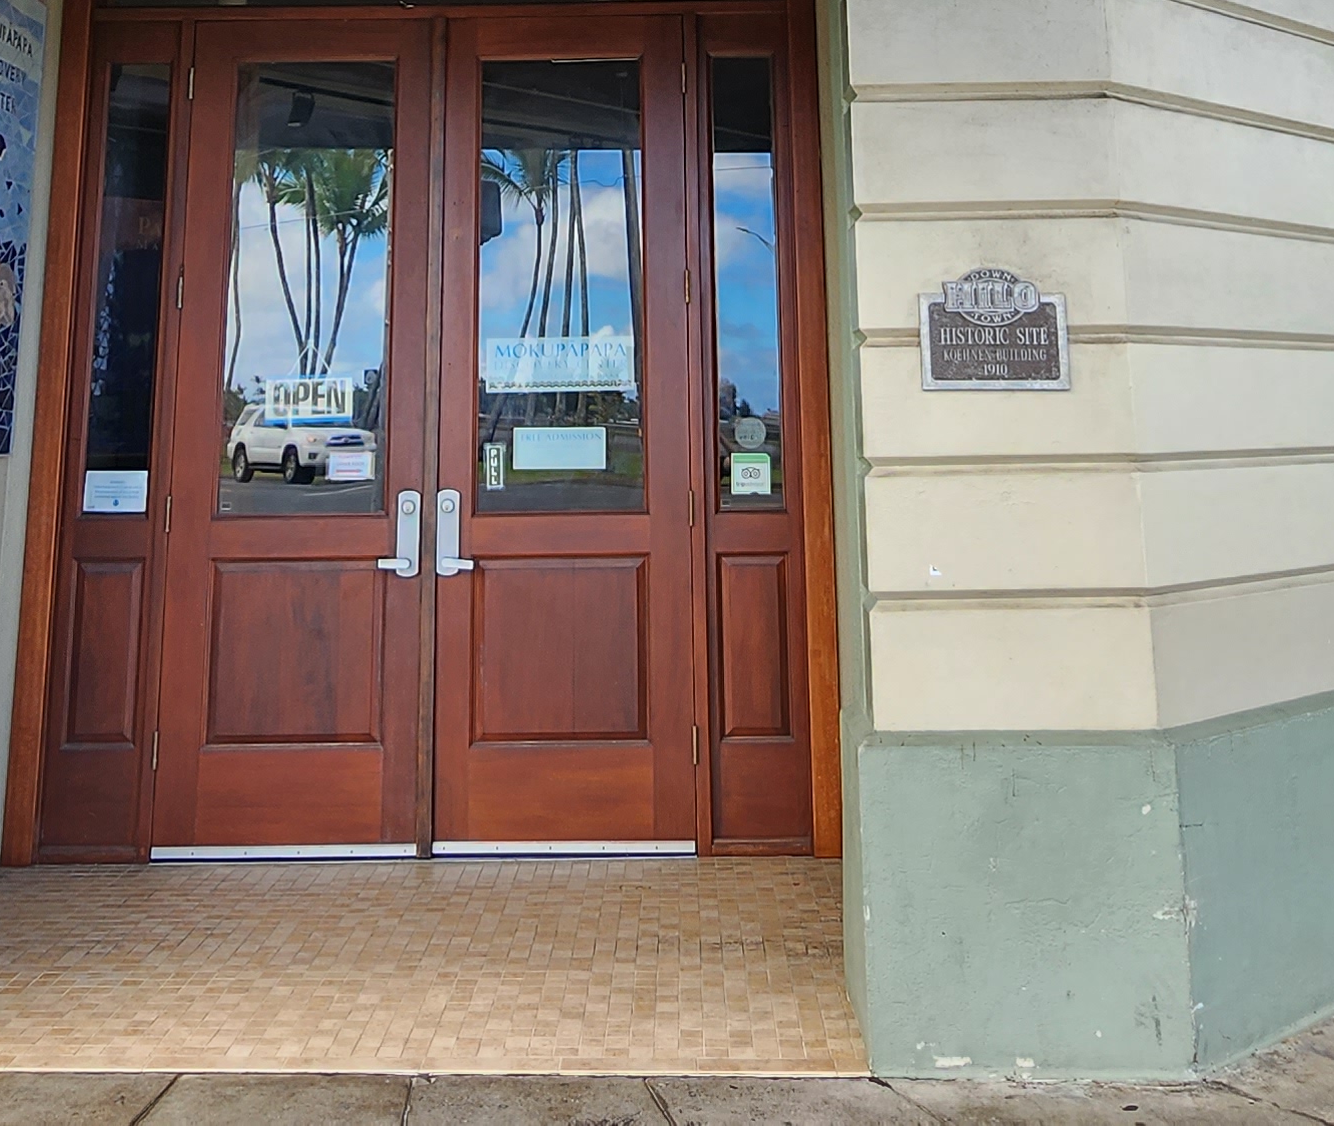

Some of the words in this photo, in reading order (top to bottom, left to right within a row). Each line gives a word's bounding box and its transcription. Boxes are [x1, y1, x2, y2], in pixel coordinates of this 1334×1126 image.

[971, 269, 1012, 282] DOWN
[945, 281, 1037, 311] HILO
[973, 312, 1012, 323] TOWN
[940, 327, 1009, 345] HISTORIC
[1016, 327, 1049, 345] SITE
[943, 348, 992, 361] KOEHNEN
[996, 347, 1047, 361] BUILDING
[493, 359, 569, 370] DISCVERY
[983, 363, 1008, 375] 1910
[273, 379, 346, 416] OPEN
[546, 432, 603, 442] ADMISSION
[490, 448, 498, 485] PULL
